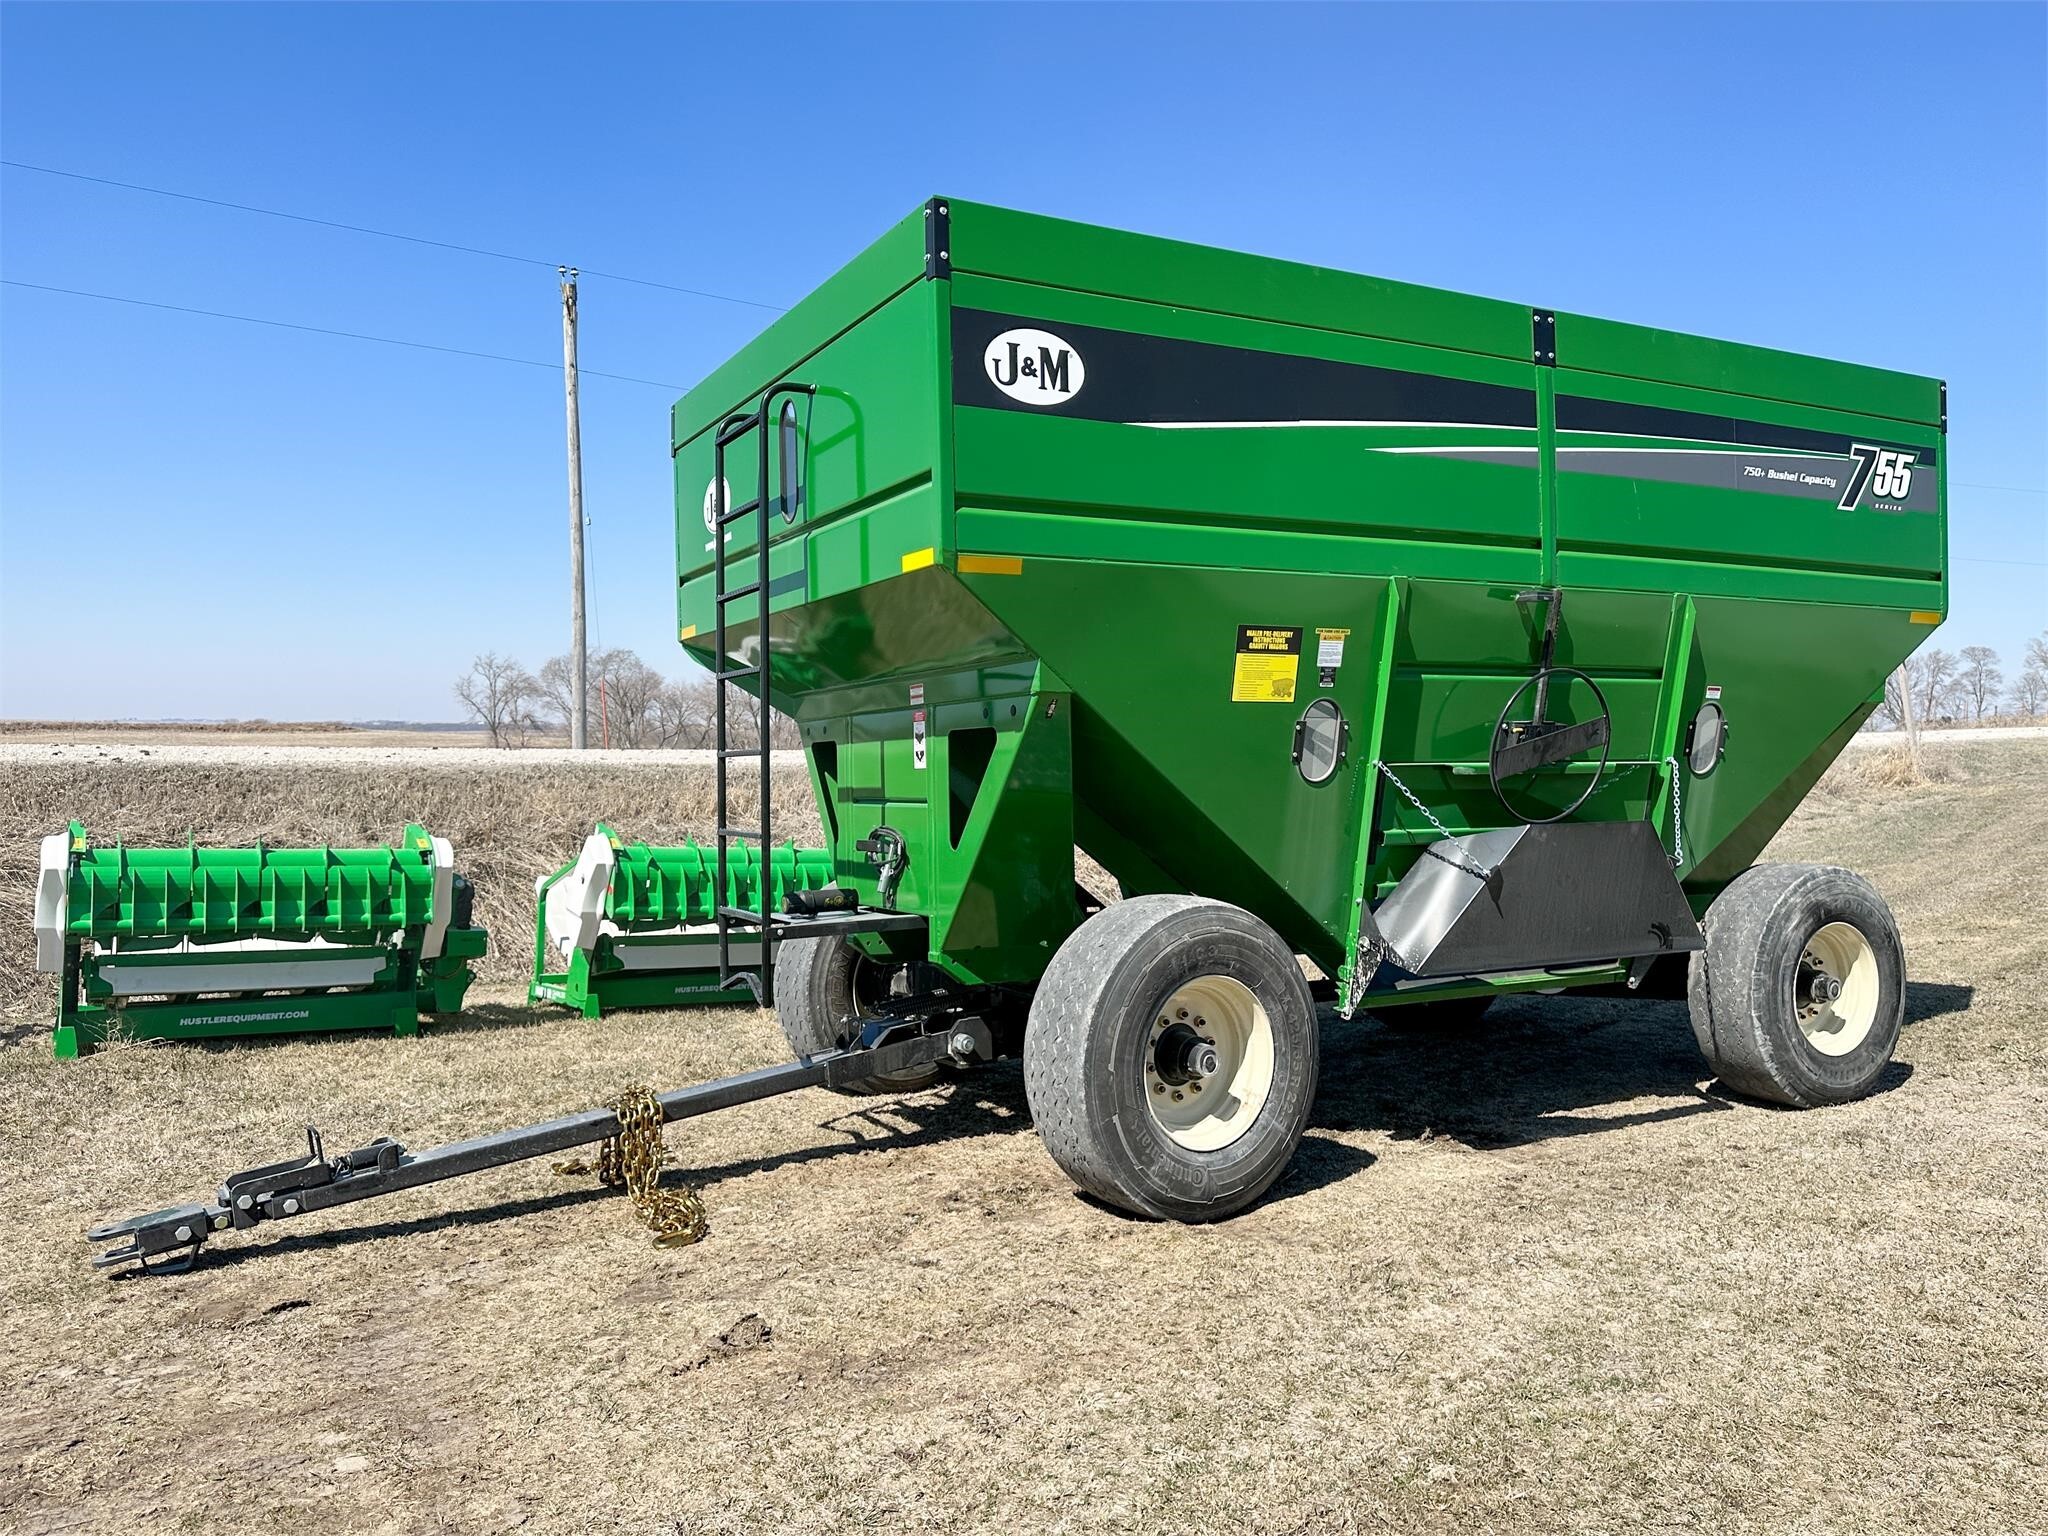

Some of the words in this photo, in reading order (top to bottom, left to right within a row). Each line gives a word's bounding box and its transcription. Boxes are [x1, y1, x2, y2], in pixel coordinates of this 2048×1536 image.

[991, 341, 1071, 393] J&M
[1743, 465, 1766, 478] 750+
[1767, 469, 1799, 482] Bushel
[1799, 473, 1837, 488] Capacity
[1837, 443, 1916, 511] 755
[1875, 503, 1902, 511] SERIES
[179, 1010, 310, 1026] HUSTLEREQUIPMENT.COM
